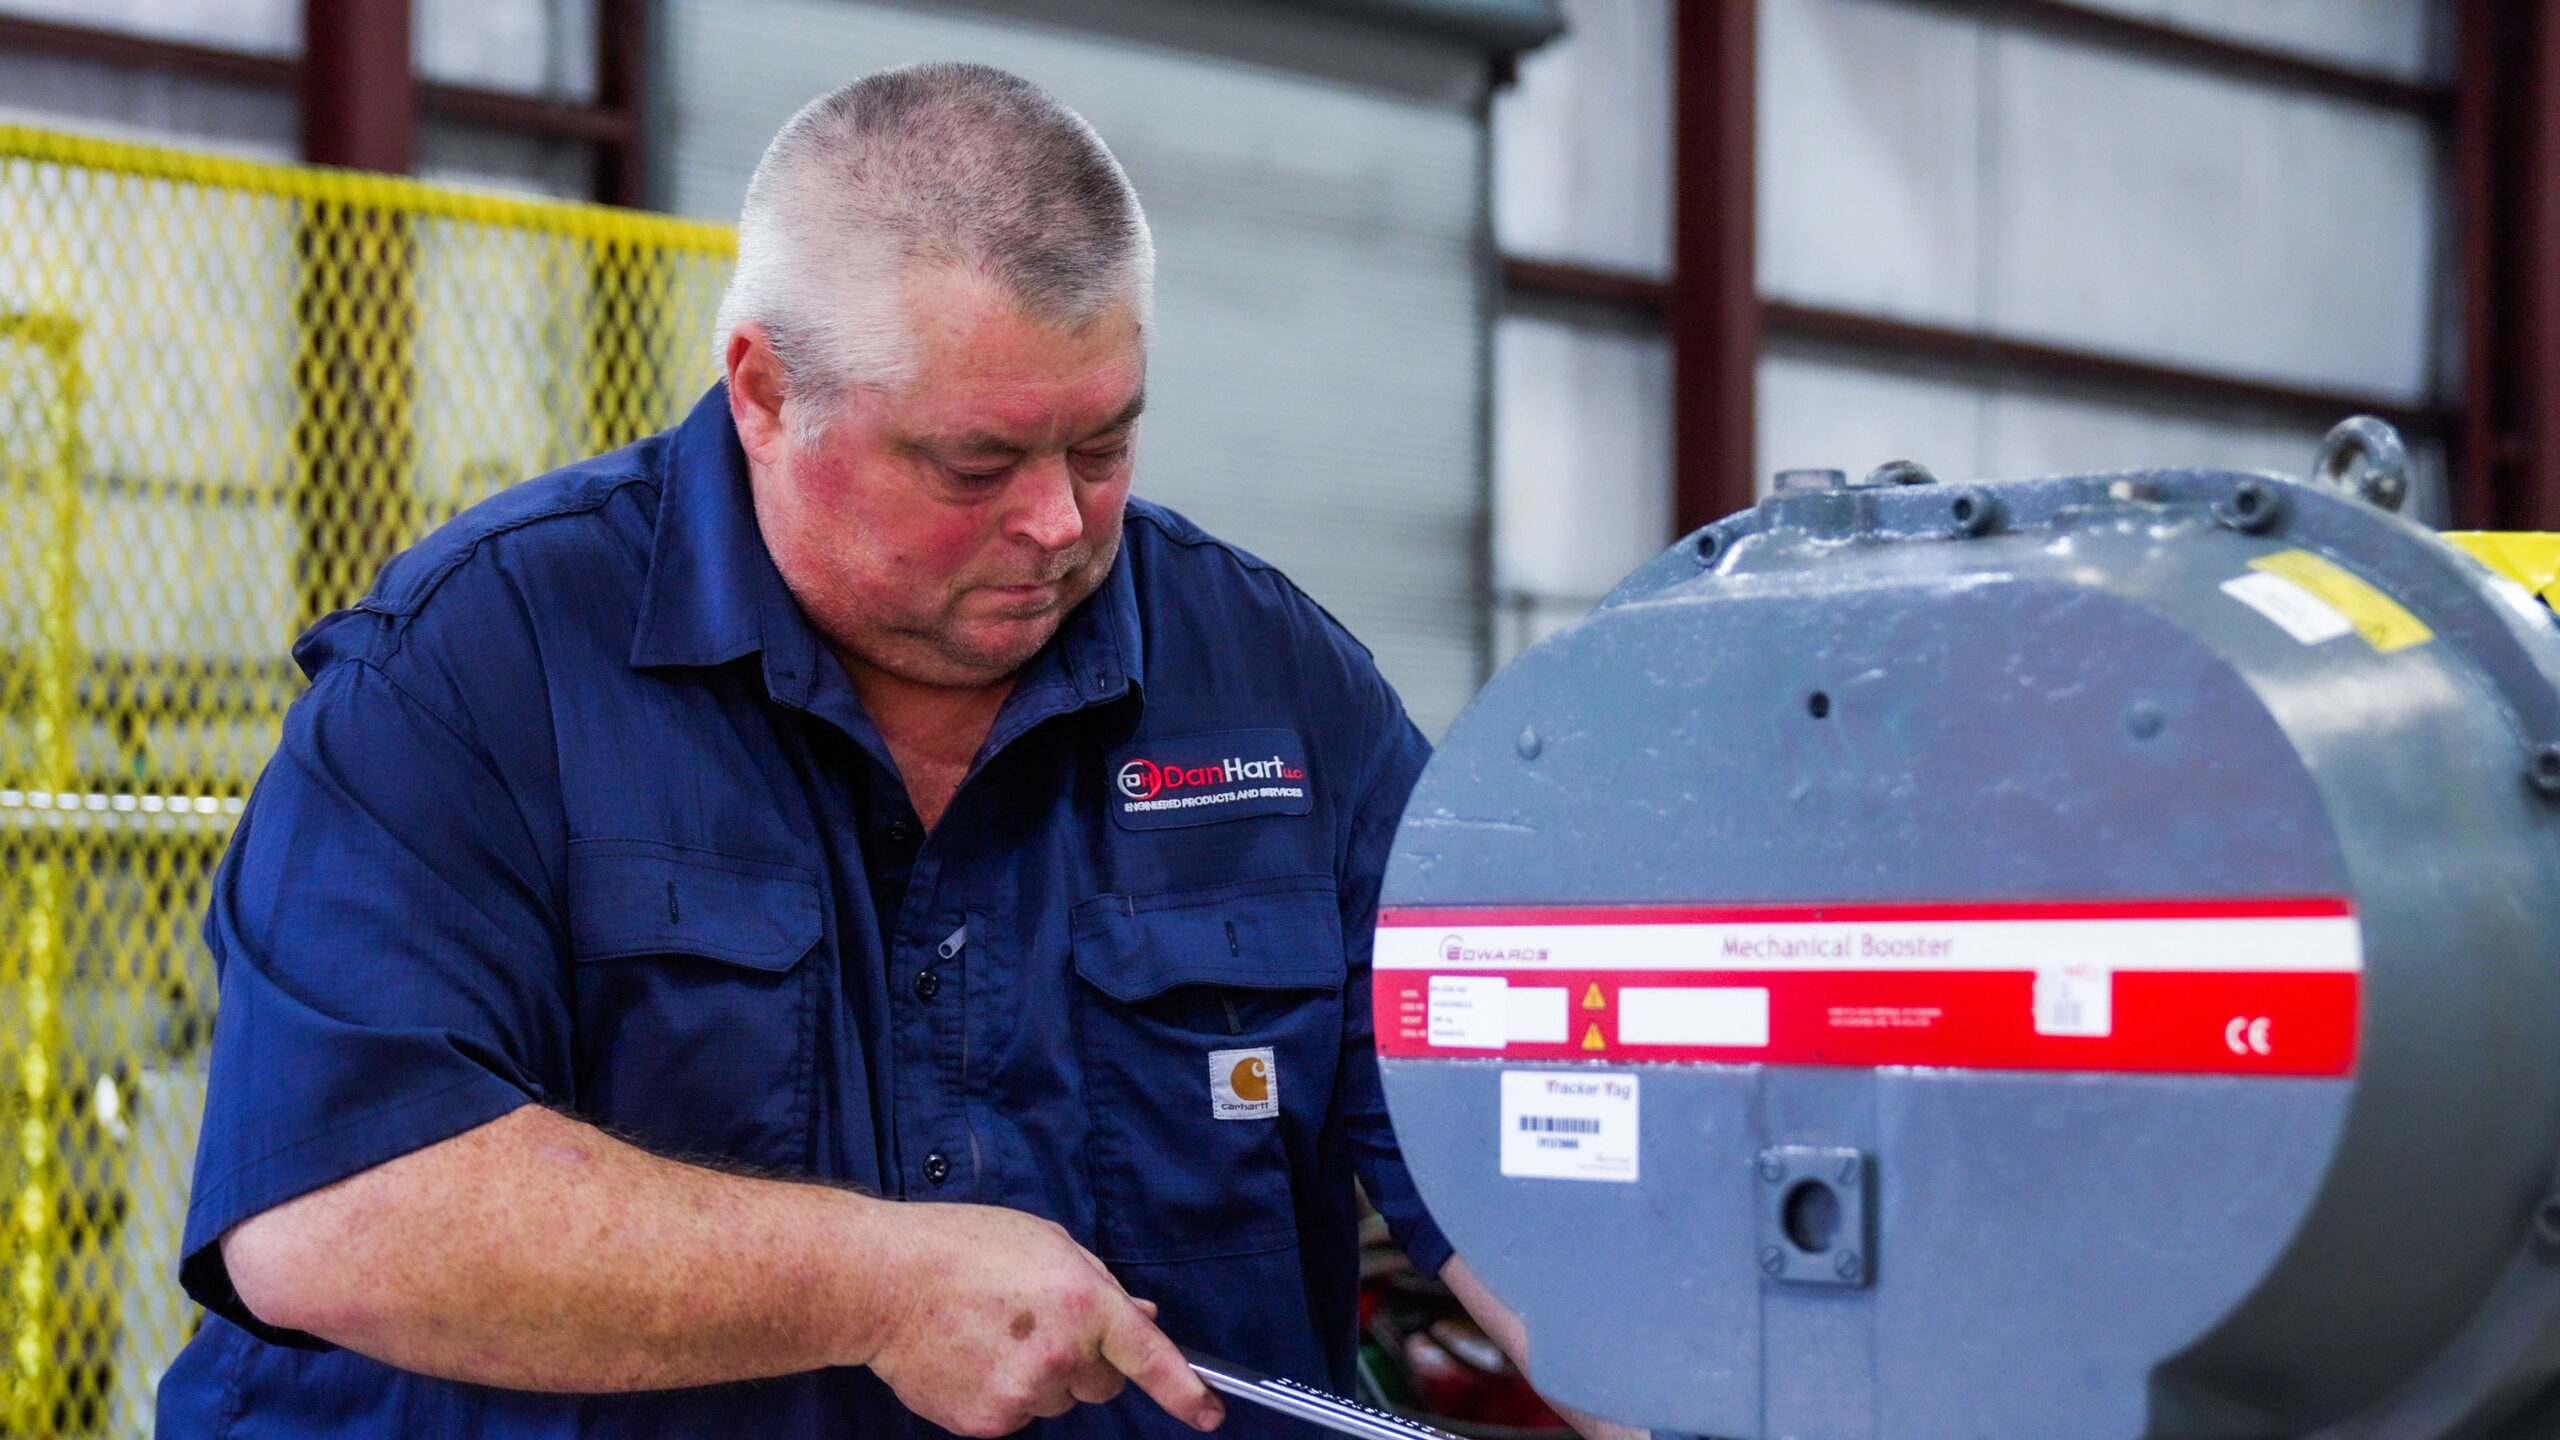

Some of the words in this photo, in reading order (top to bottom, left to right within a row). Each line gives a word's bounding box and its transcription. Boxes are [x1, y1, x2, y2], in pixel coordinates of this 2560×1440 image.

[1163, 755, 1284, 789] DanHart
[1283, 769, 1304, 780] LLC
[1124, 799, 1182, 812] ENGINEERED
[1182, 792, 1236, 807] PRODUCTS
[1237, 788, 1259, 801] AND
[1260, 787, 1303, 799] SERVICES
[1721, 934, 1852, 959] Mechanical
[1861, 933, 1953, 958] Booster
[1546, 1080, 1598, 1095] Tracker
[1604, 1081, 1631, 1100] Tag
[1221, 1102, 1269, 1111] carhartt
